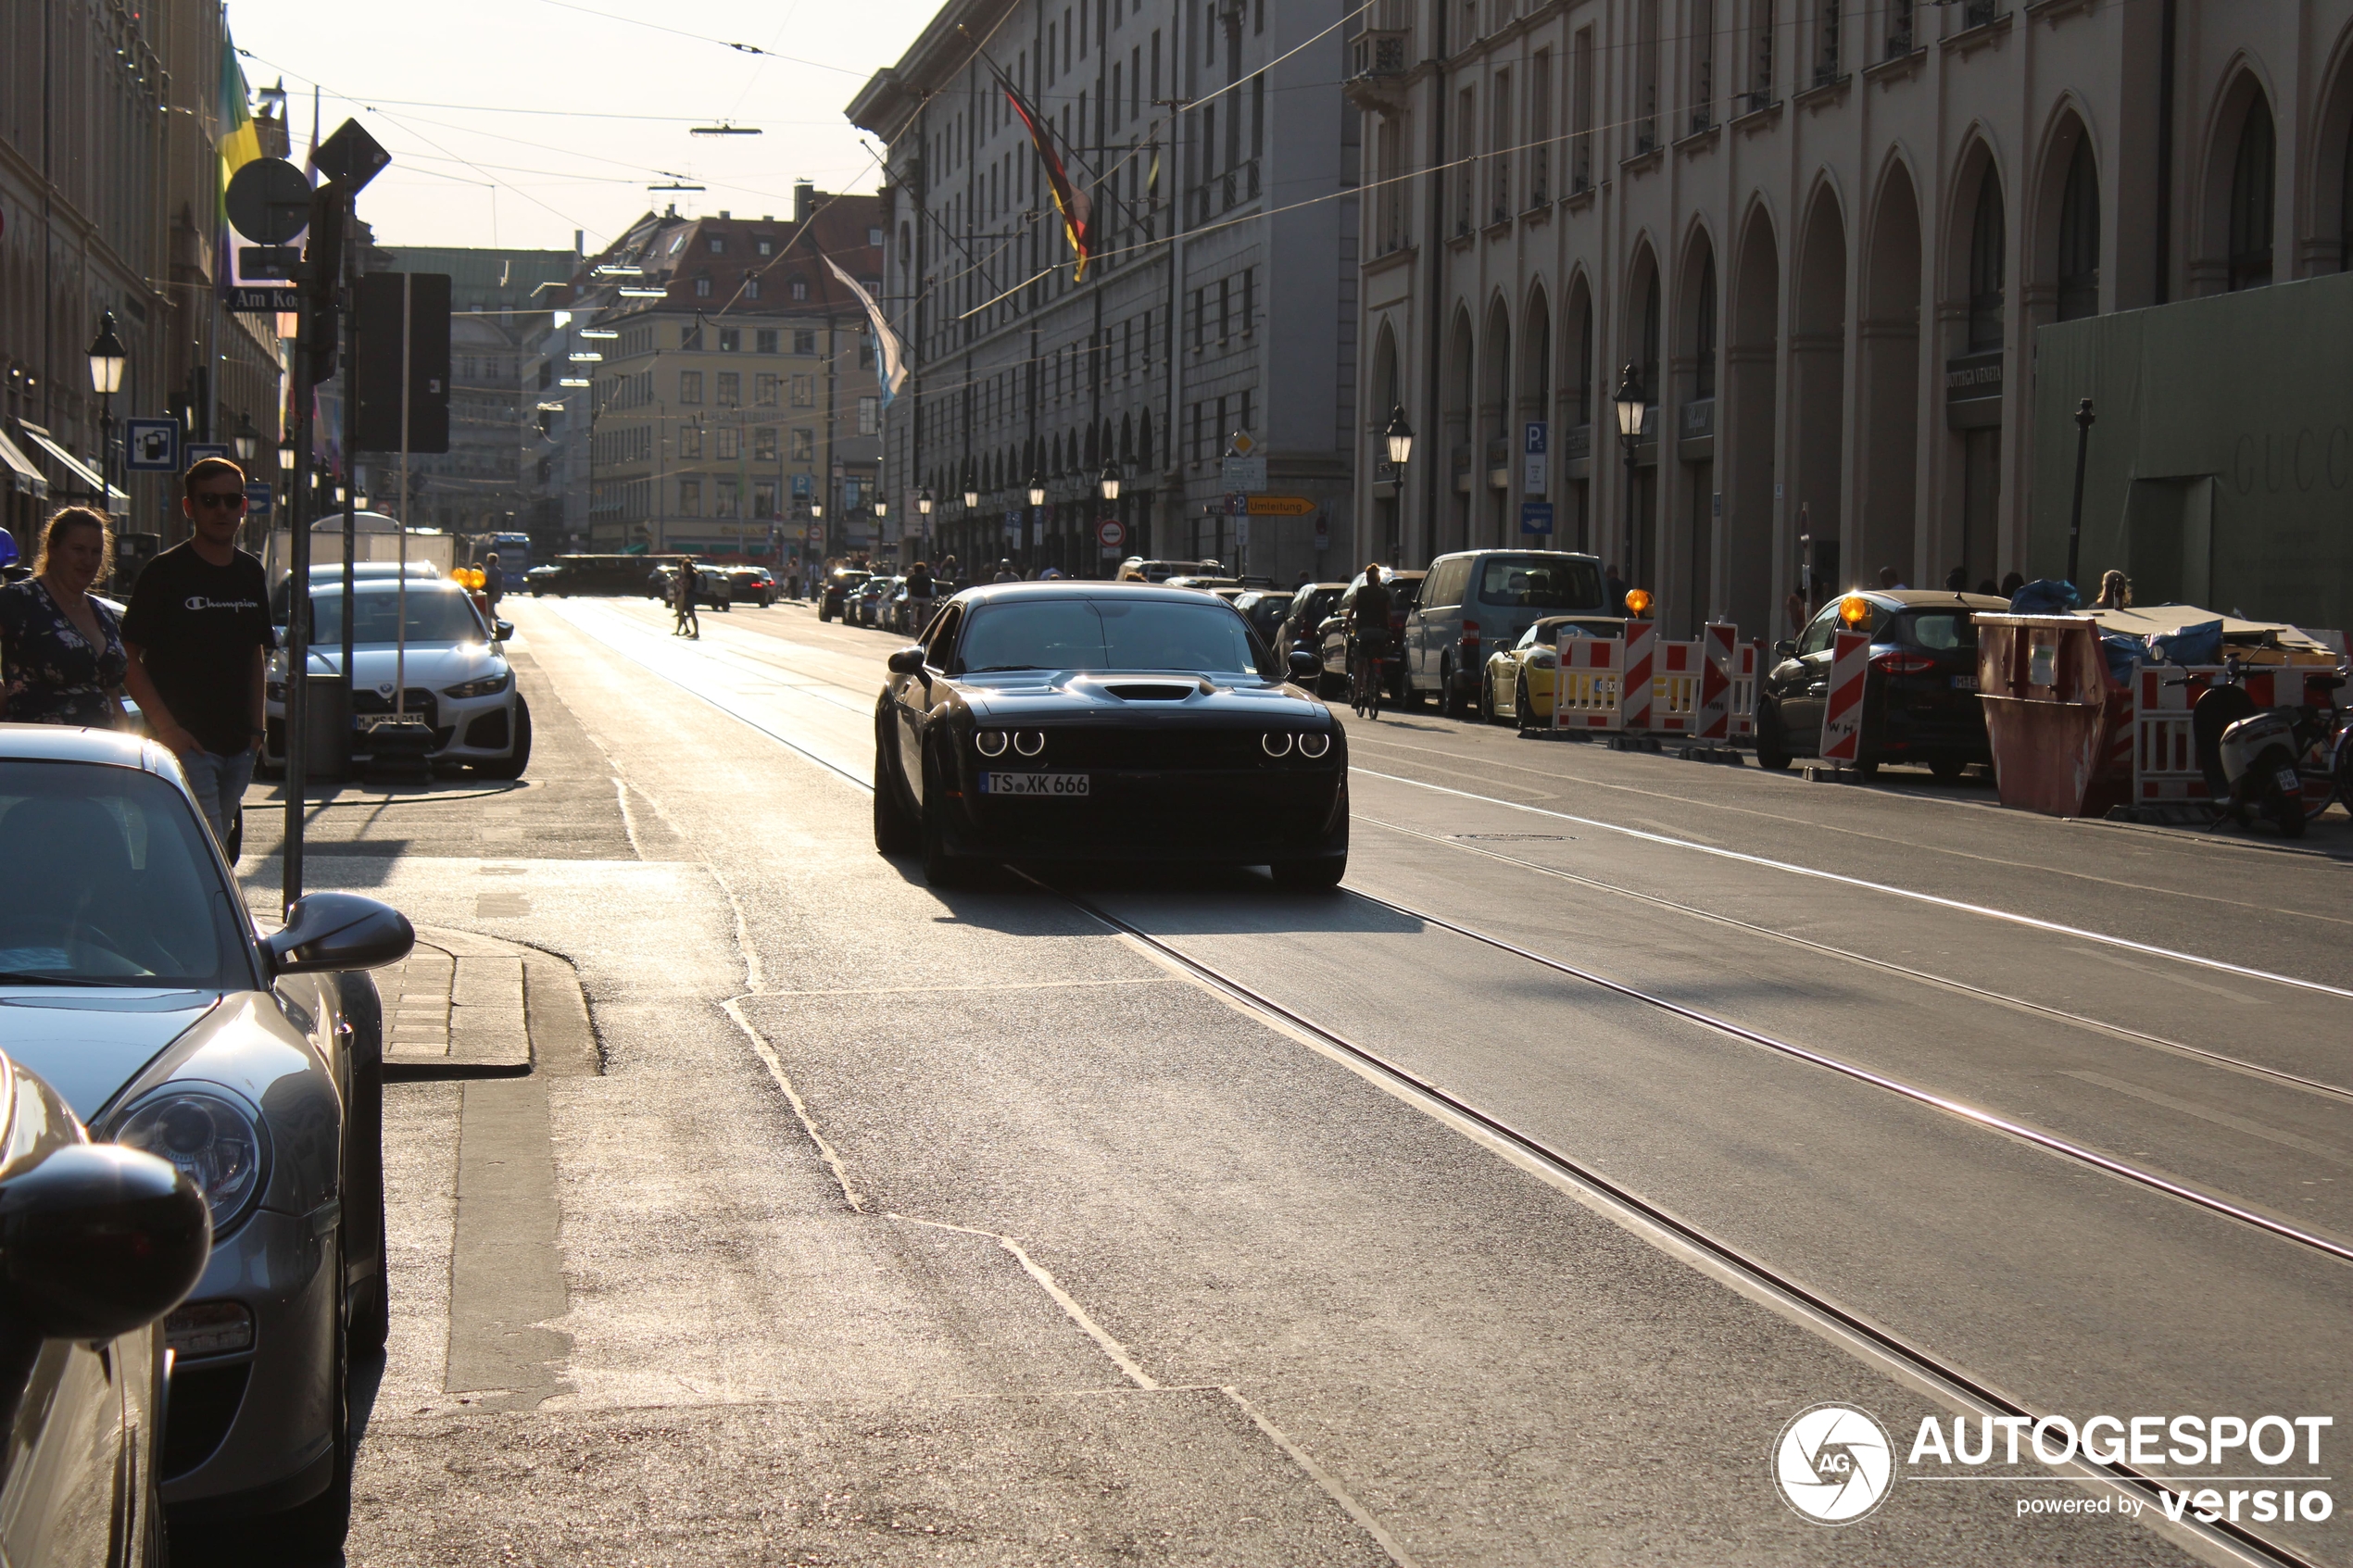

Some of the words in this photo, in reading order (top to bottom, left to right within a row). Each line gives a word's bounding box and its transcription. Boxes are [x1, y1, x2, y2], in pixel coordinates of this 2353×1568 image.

[236, 290, 266, 307] Am
[273, 290, 297, 307] Ko
[1975, 365, 2001, 383] VENETA
[1529, 426, 1541, 450] P
[797, 477, 805, 488] P
[1238, 495, 1245, 514] P
[1250, 501, 1302, 513] Umleitung
[185, 596, 258, 613] Champion
[1957, 677, 1964, 687] M
[358, 716, 365, 728] M
[990, 774, 1013, 792] TS
[1026, 775, 1049, 793] XK
[1054, 776, 1088, 794] 666
